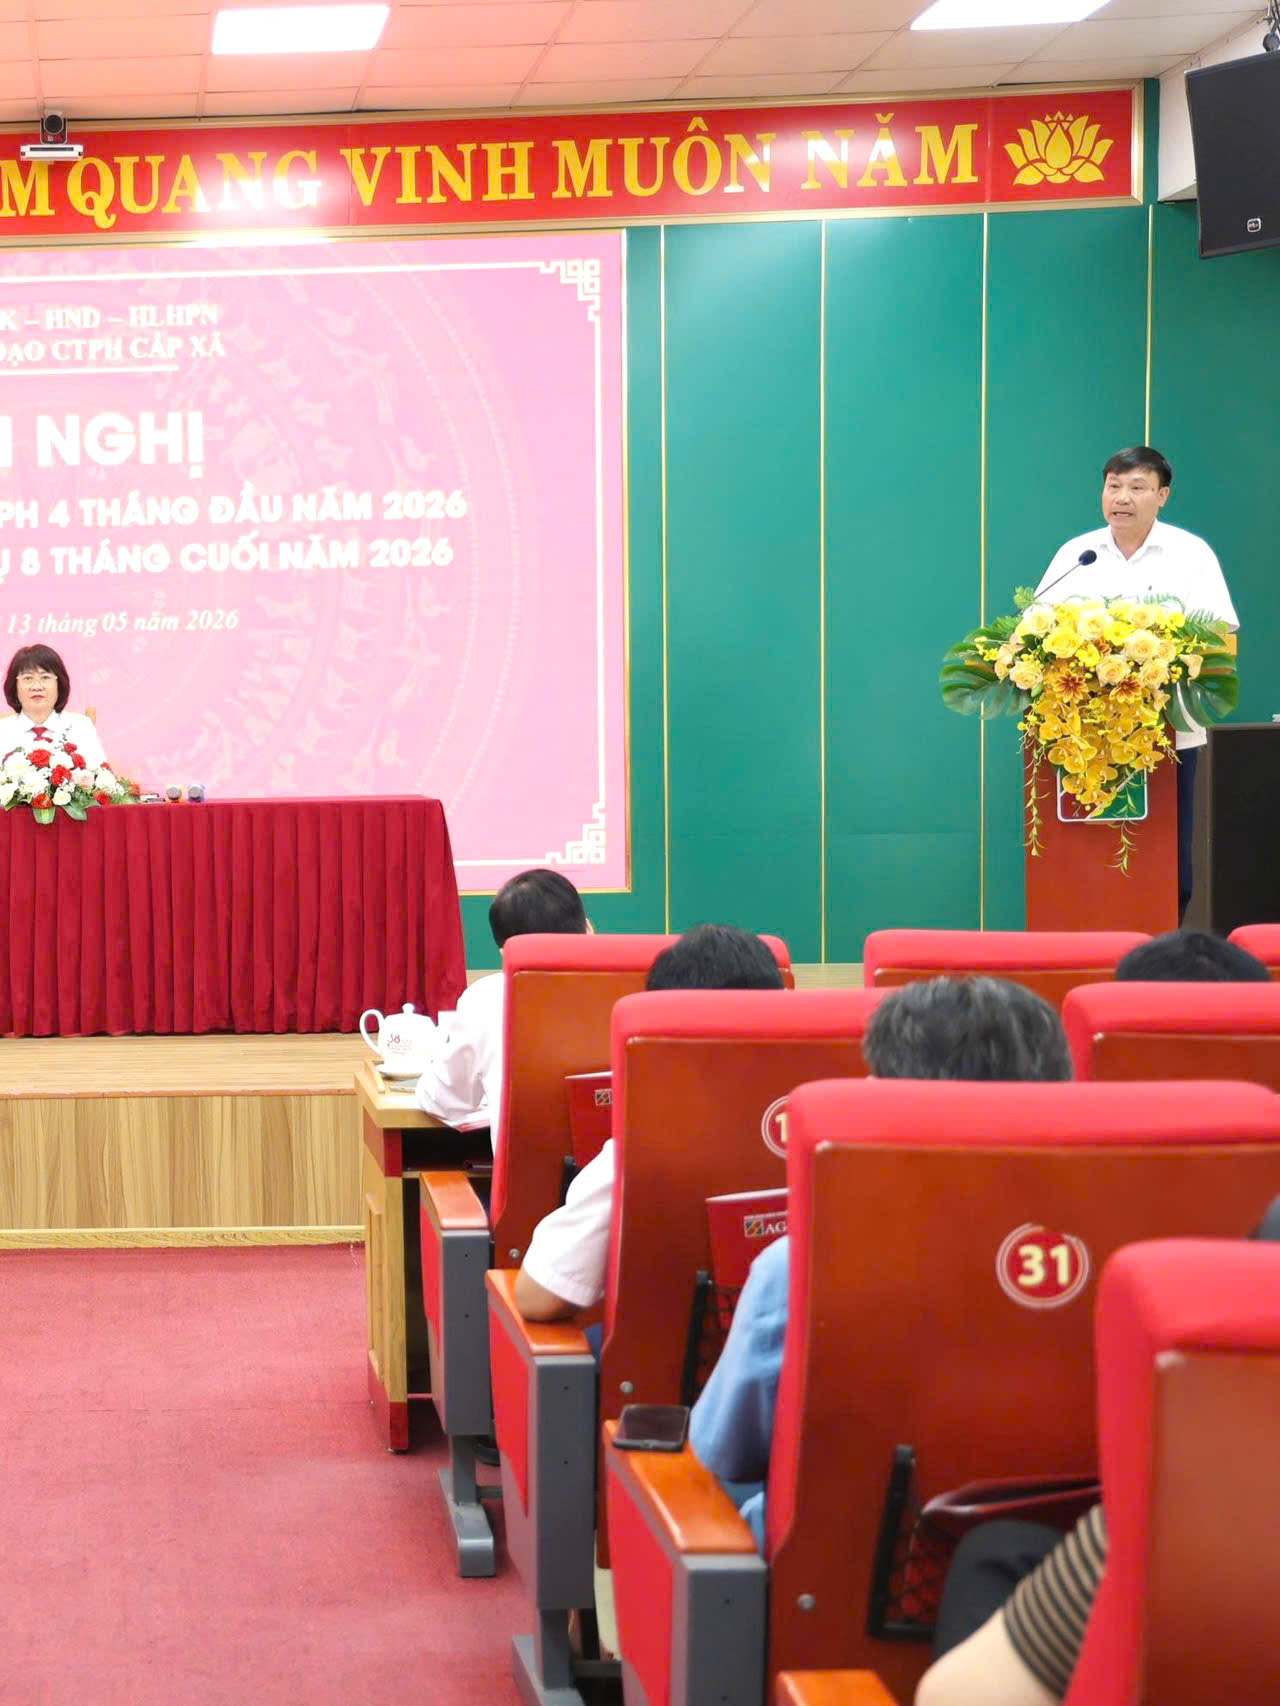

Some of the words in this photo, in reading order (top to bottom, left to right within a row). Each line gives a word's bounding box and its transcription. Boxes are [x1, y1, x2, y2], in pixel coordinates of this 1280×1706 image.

[66, 148, 322, 229] QUANG
[340, 141, 535, 206] VINH
[551, 117, 776, 198] MUÔN
[800, 112, 978, 189] NĂM
[44, 306, 101, 330] HND
[51, 337, 126, 362] CTPH
[37, 410, 204, 479] NGHỊ
[48, 502, 71, 527] 4
[79, 490, 200, 526] THÁNG
[209, 480, 284, 524] ĐẦU
[292, 486, 373, 521] NĂM
[383, 490, 468, 520] 2026
[21, 547, 41, 575] 8
[50, 538, 170, 574] THÁNG
[180, 531, 269, 572] CUỐI
[279, 534, 359, 570] NĂM
[369, 538, 454, 568] 2026
[7, 615, 31, 634] 13
[38, 611, 97, 637] tháng
[102, 611, 128, 632] 05
[135, 611, 180, 631] năm
[186, 609, 239, 630] 2026
[1018, 1245, 1069, 1286] 31
